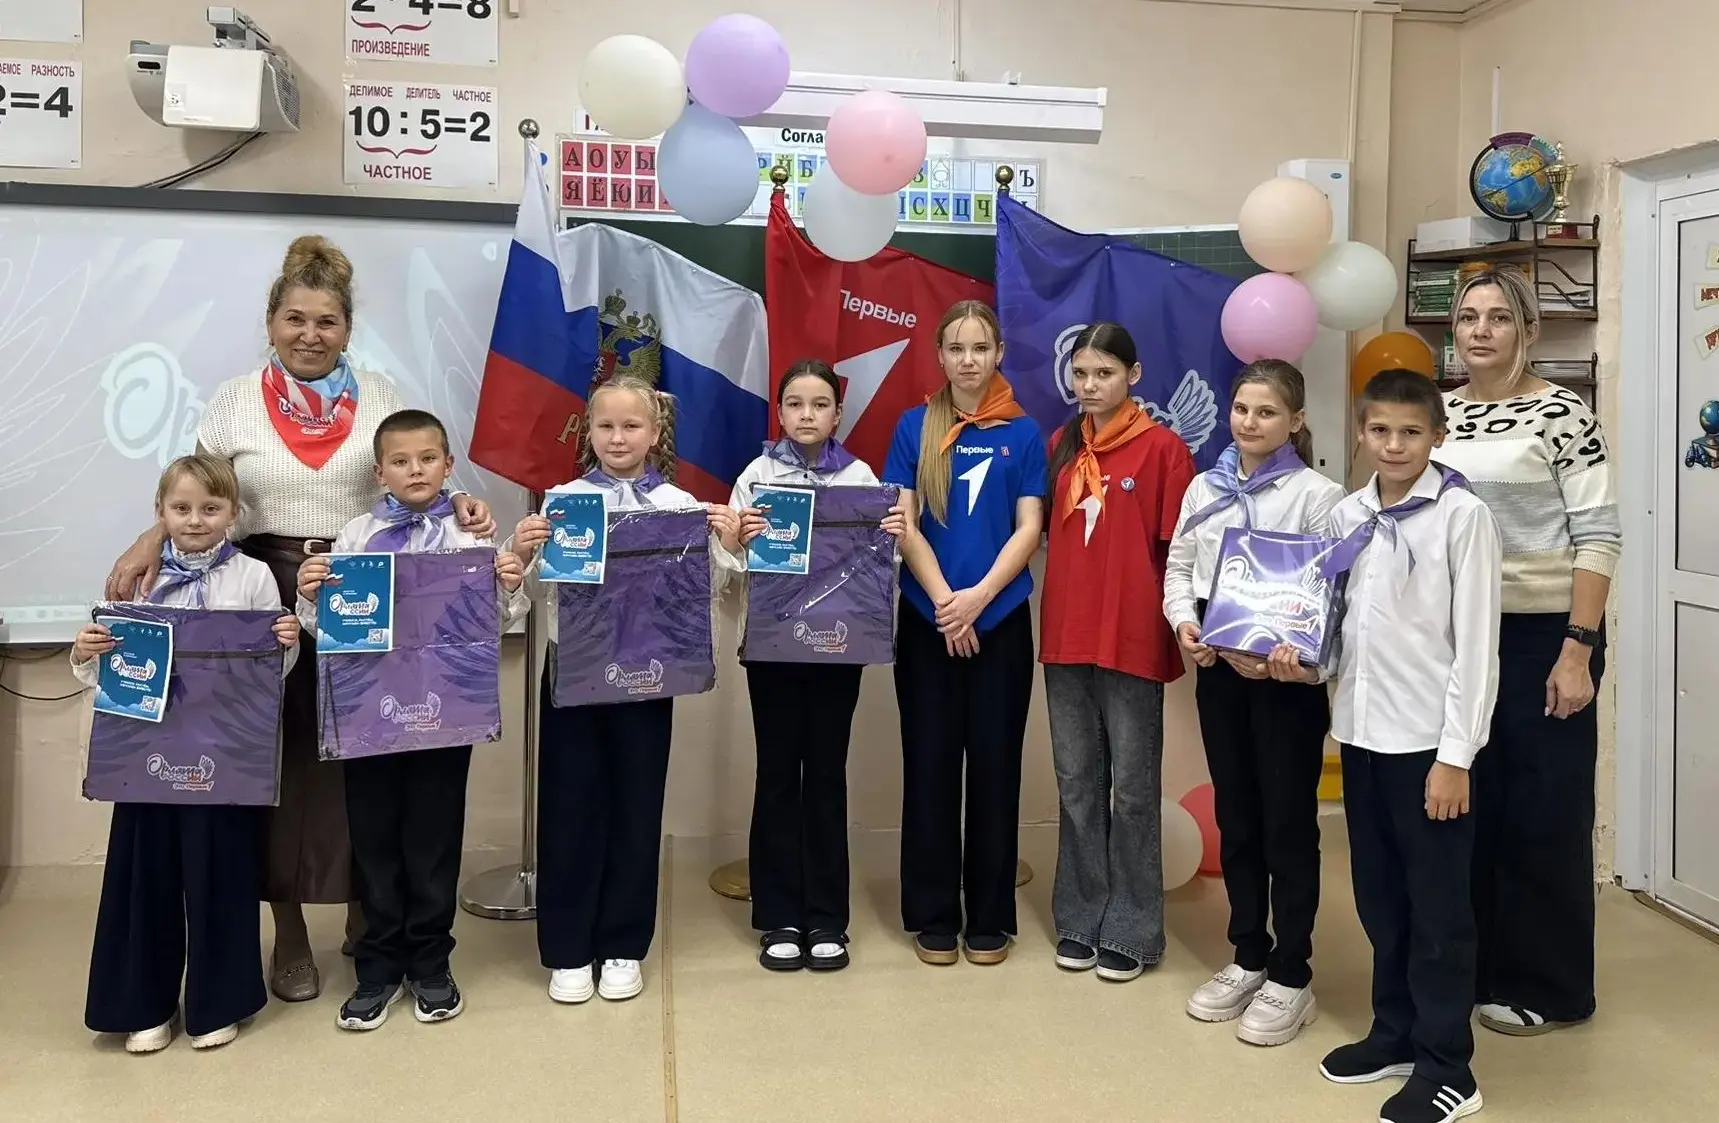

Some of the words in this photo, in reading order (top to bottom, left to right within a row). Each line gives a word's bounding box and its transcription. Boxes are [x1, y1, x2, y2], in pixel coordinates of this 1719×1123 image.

[352, 39, 430, 57] ПРОИЗВЕДЕНИЕ
[31, 64, 75, 77] РАЗНОСТЬ
[349, 84, 393, 98] ДЕЛИМОЕ
[406, 87, 441, 100] ДЕЛИТЕЛЬ
[452, 89, 492, 103] ЧАСТНОЕ
[349, 105, 390, 137] 10
[564, 147, 581, 166] А
[589, 148, 604, 168] О
[614, 150, 629, 169] У
[636, 151, 656, 170] Ы
[363, 164, 432, 181] ЧАСТНОЕ
[1019, 169, 1035, 187] Ъ
[564, 180, 581, 200] Я
[611, 183, 632, 203] Ю
[636, 184, 653, 204] И
[933, 198, 948, 216] Х
[955, 199, 970, 221] Ц
[978, 200, 991, 217] Ч
[840, 289, 917, 328] Первые
[956, 445, 994, 456] Первые
